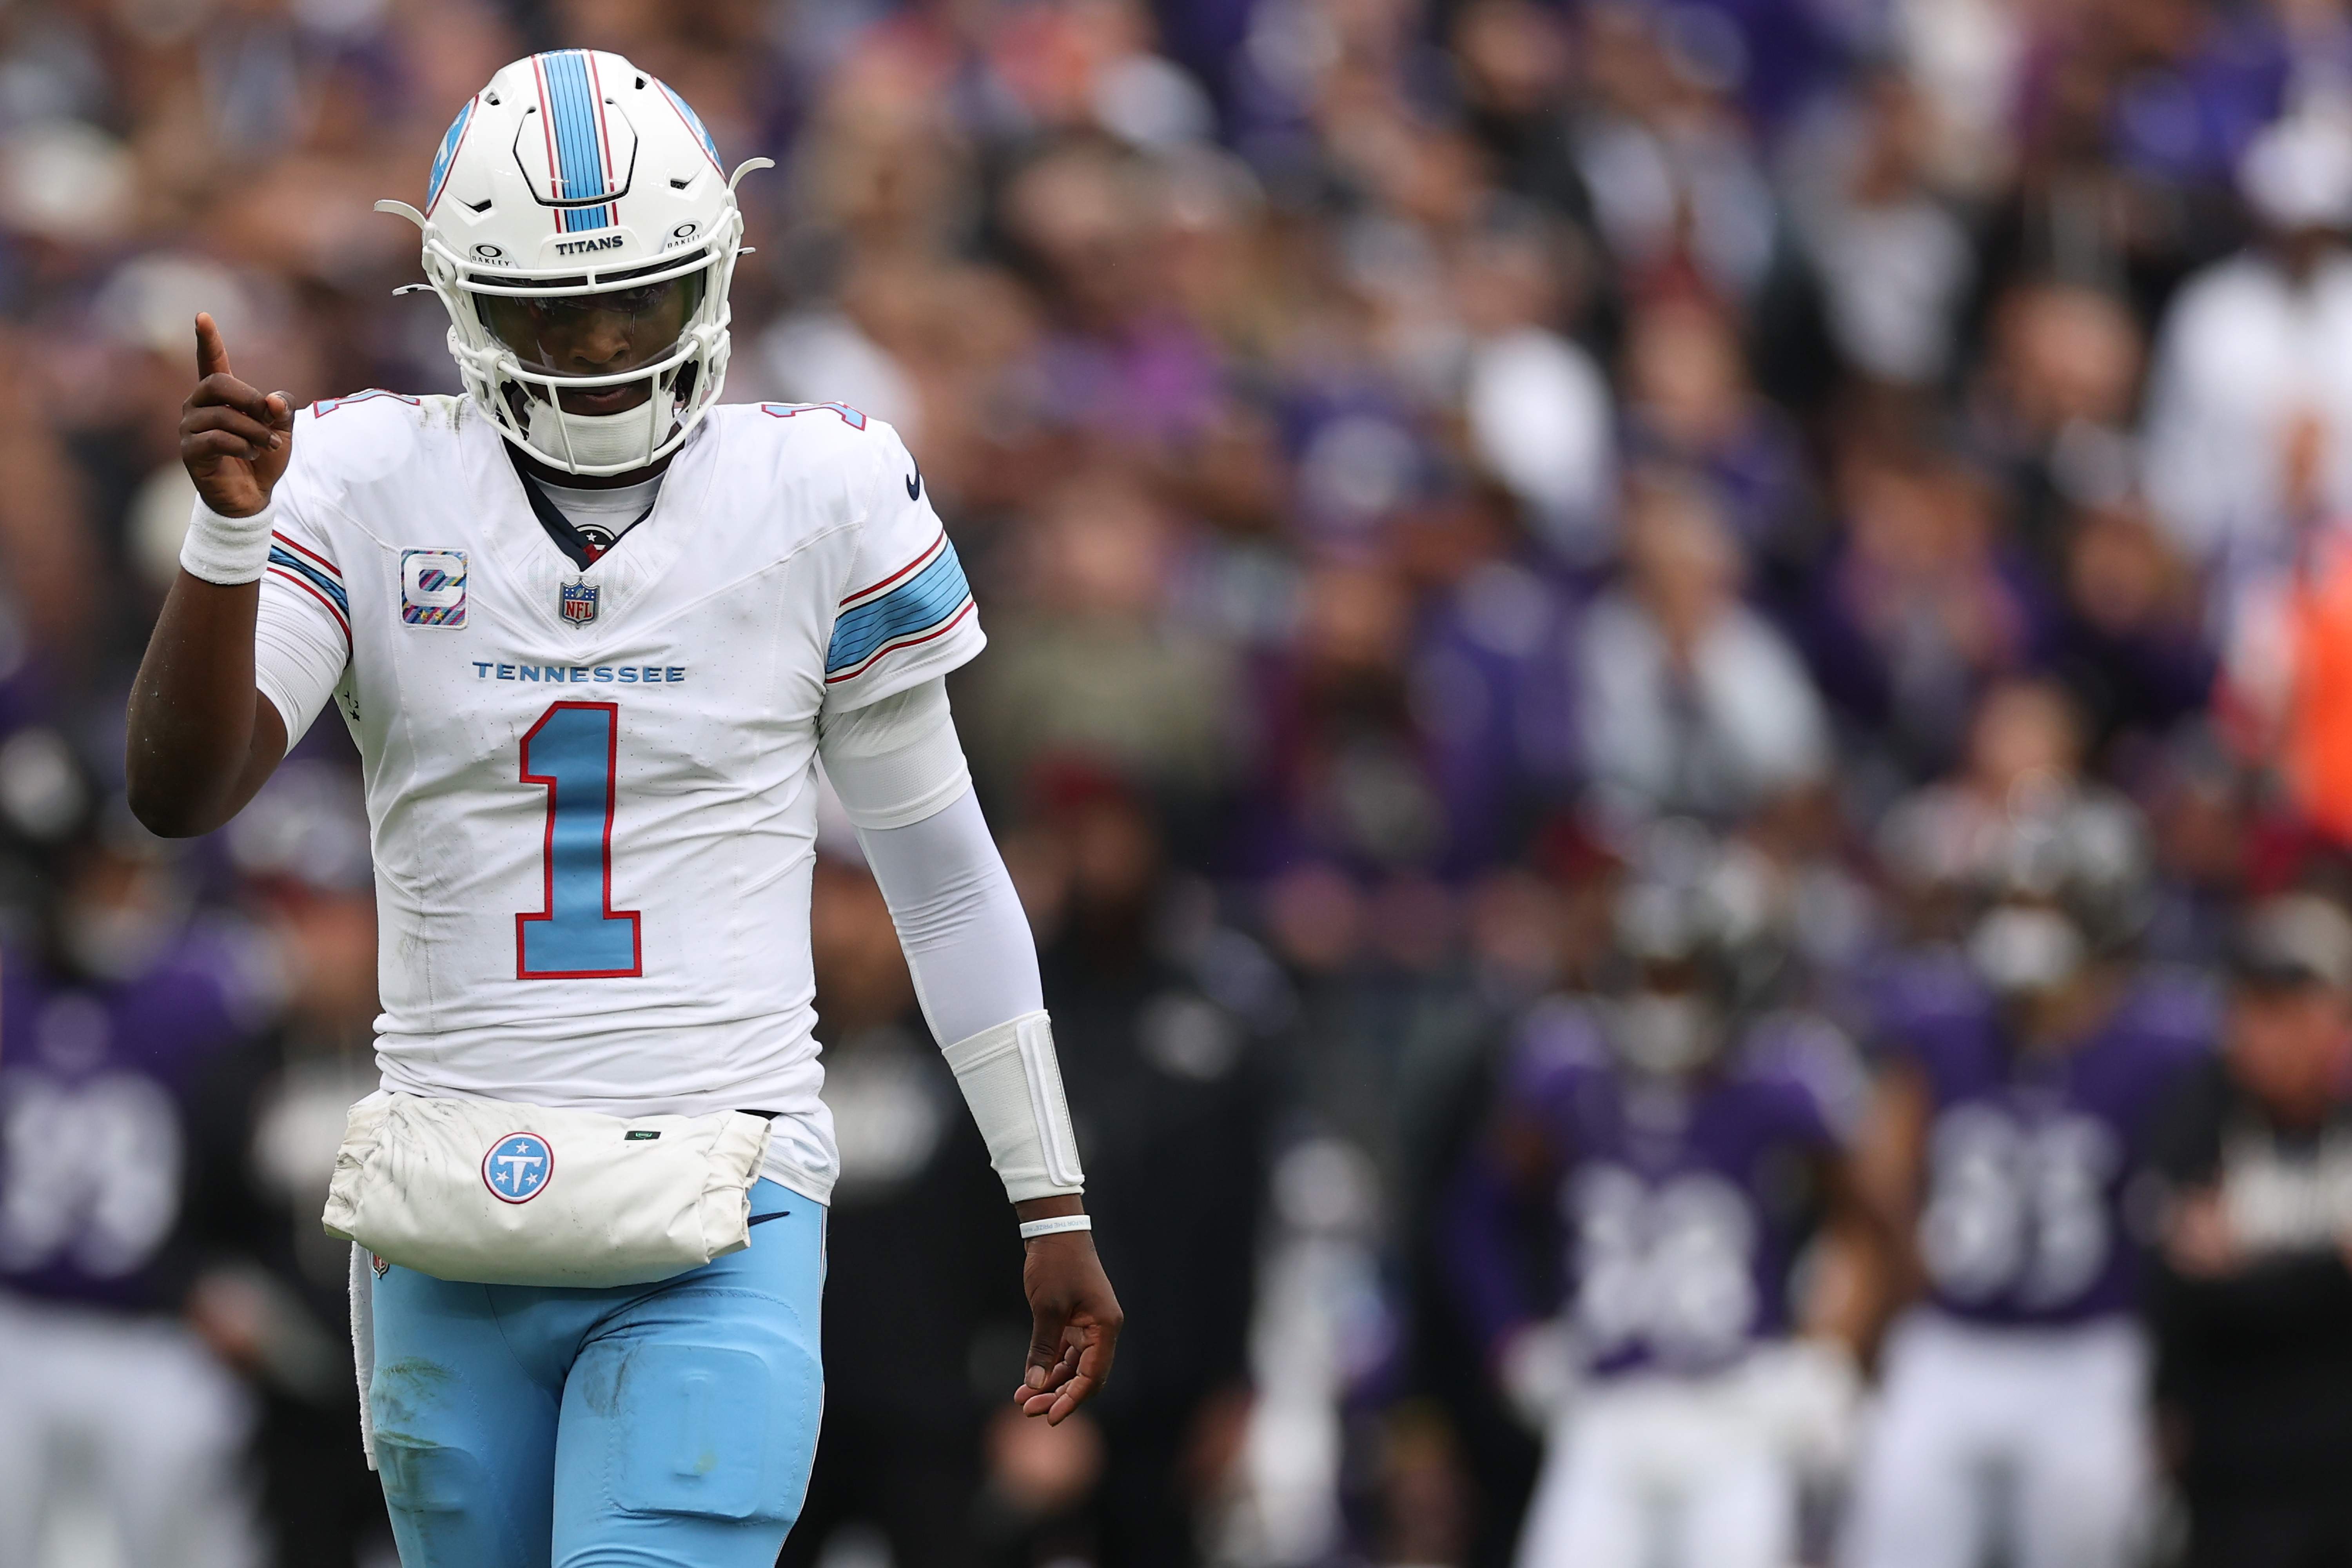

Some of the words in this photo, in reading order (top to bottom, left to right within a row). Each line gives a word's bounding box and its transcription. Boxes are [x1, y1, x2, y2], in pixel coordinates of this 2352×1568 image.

[556, 235, 624, 255] TITANS
[668, 234, 701, 248] OAKLEY
[472, 256, 510, 266] OAKLEY
[404, 554, 464, 608] C
[565, 601, 592, 620] NFL
[472, 662, 686, 682] TENNESSEE
[515, 701, 642, 980] 1
